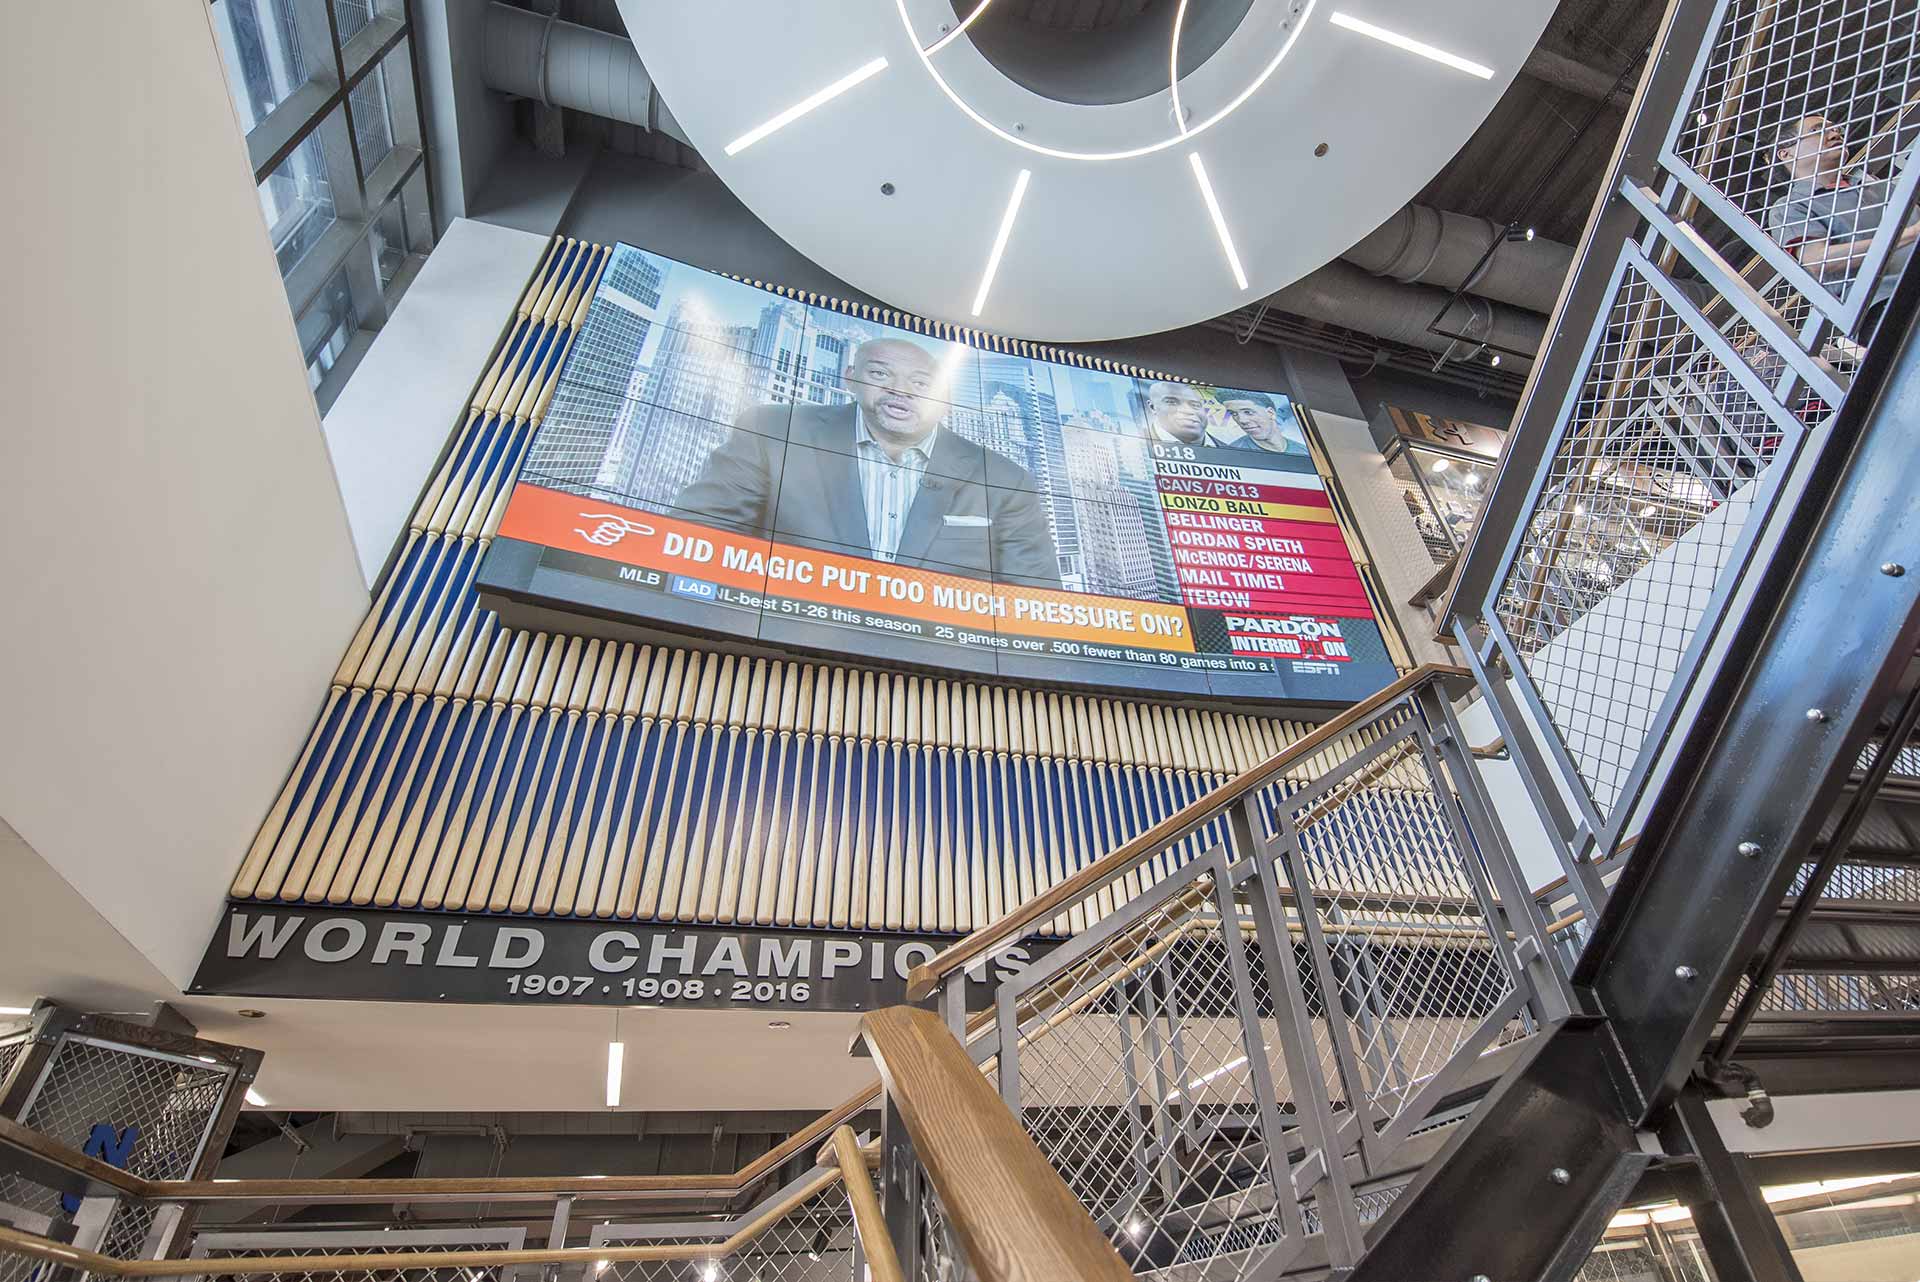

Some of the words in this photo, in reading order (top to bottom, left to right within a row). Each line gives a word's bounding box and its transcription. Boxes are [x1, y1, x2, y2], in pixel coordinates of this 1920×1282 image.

[1155, 461, 1241, 481] RUNDOWN
[1163, 494, 1220, 512] LONZO
[1226, 500, 1269, 516] BALL
[1167, 511, 1265, 533] BELLINGER
[1172, 530, 1240, 549] JORDAN
[1245, 536, 1305, 554] SPIETH
[619, 566, 661, 585] MLB
[662, 531, 715, 563] DID
[721, 545, 814, 584] MAGIC
[821, 564, 873, 595] PUT
[876, 574, 926, 603] TOO
[932, 584, 1006, 618] MUCH
[1014, 597, 1137, 633] PRESSURE
[1140, 613, 1185, 638] ON?
[1180, 567, 1229, 587] MAIL
[1230, 571, 1286, 591] TIME!
[678, 580, 712, 596] LAD
[1182, 588, 1250, 609] TEBOW
[780, 599, 828, 619] 51-26
[831, 608, 861, 624] this
[865, 616, 922, 634] season
[1225, 615, 1342, 638] PARDON
[935, 625, 955, 639] 25
[958, 631, 1009, 648] games
[1012, 638, 1045, 651] over
[1049, 641, 1080, 655] .500
[1083, 644, 1122, 659] fewer
[1124, 648, 1157, 663] than
[1159, 652, 1177, 665] 80
[1180, 656, 1227, 670] games
[1229, 658, 1257, 671] into
[1291, 660, 1340, 676] ESPN
[226, 912, 546, 969] WORLD
[506, 974, 594, 998] 1907
[621, 977, 705, 1000] 1908
[731, 980, 811, 1002] 2016
